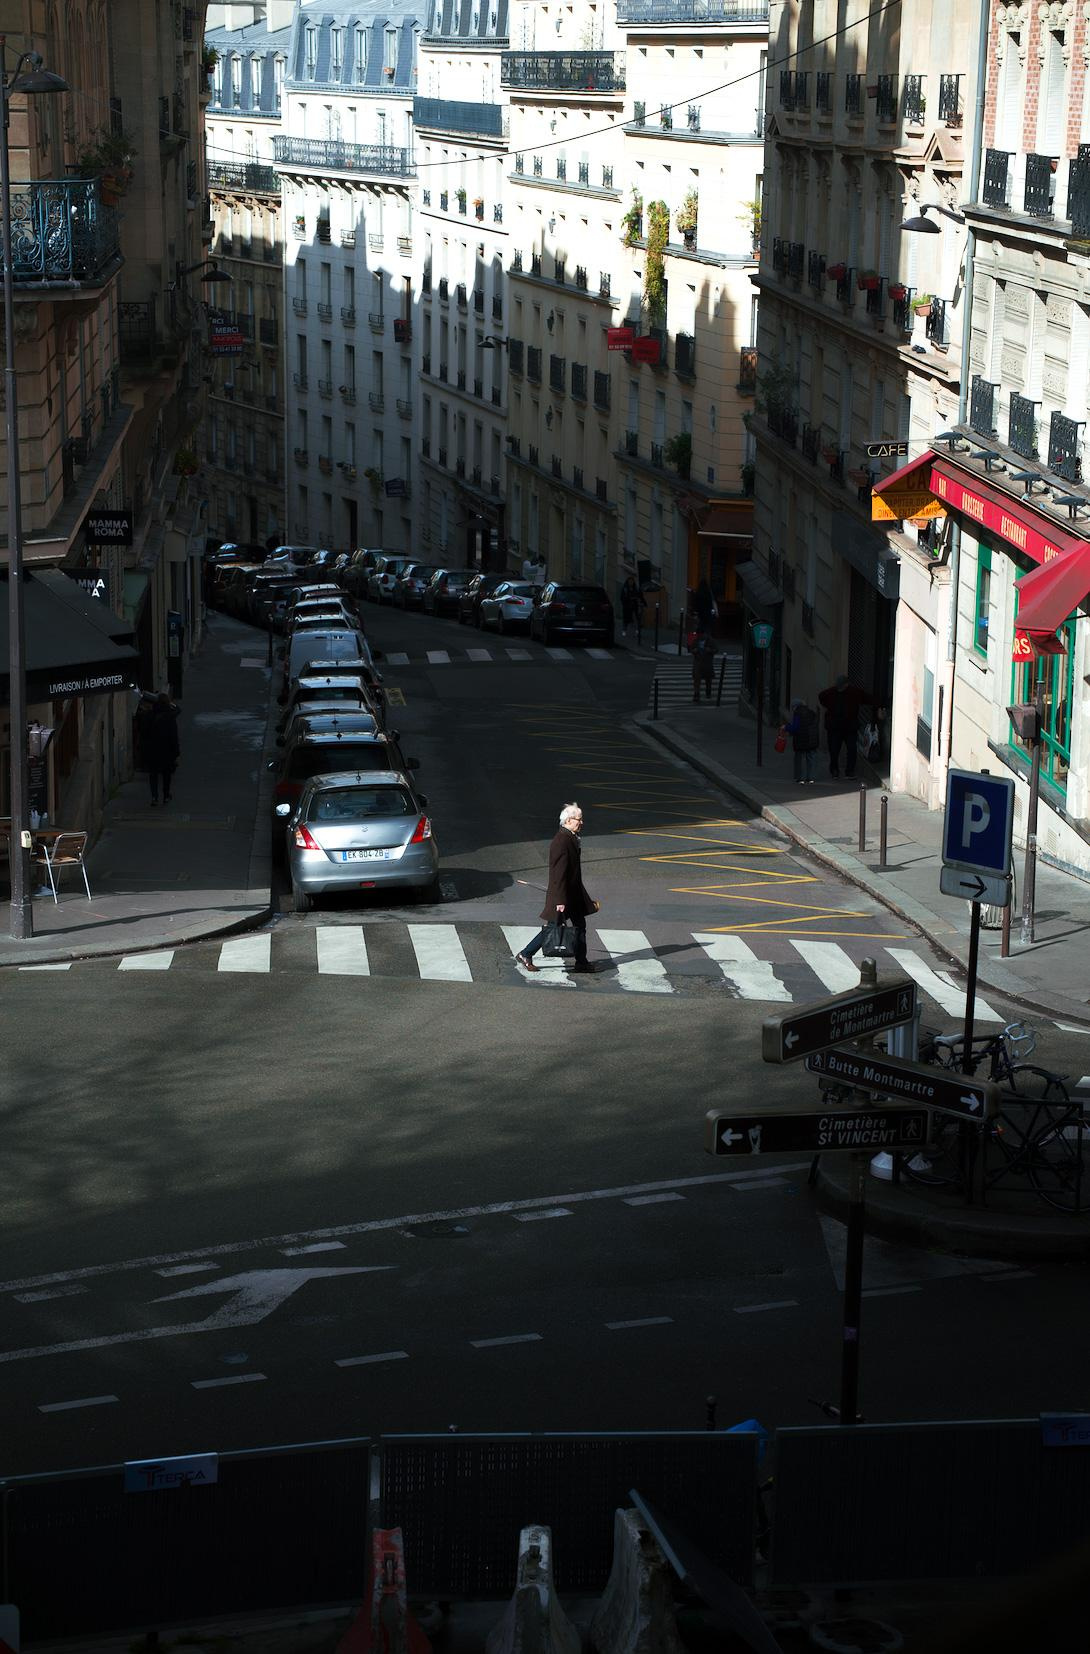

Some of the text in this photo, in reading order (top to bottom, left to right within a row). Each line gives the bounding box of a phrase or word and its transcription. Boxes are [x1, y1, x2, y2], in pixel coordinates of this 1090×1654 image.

[867, 444, 907, 457] CAFE
[961, 491, 985, 521] BRASSERIE
[88, 519, 129, 529] MAMMA
[94, 528, 125, 537] ROMA
[1000, 515, 1028, 550] RESTAURANT
[49, 680, 81, 694] LIVRAISON
[90, 674, 123, 689] EMPORTER
[961, 791, 991, 849] P
[830, 1002, 874, 1025] Cimetière
[830, 1009, 896, 1041] de Montmartre
[828, 1056, 935, 1097] Butte Montmartre
[818, 1115, 888, 1132] Cimetière
[818, 1129, 897, 1146] St VINCENT
